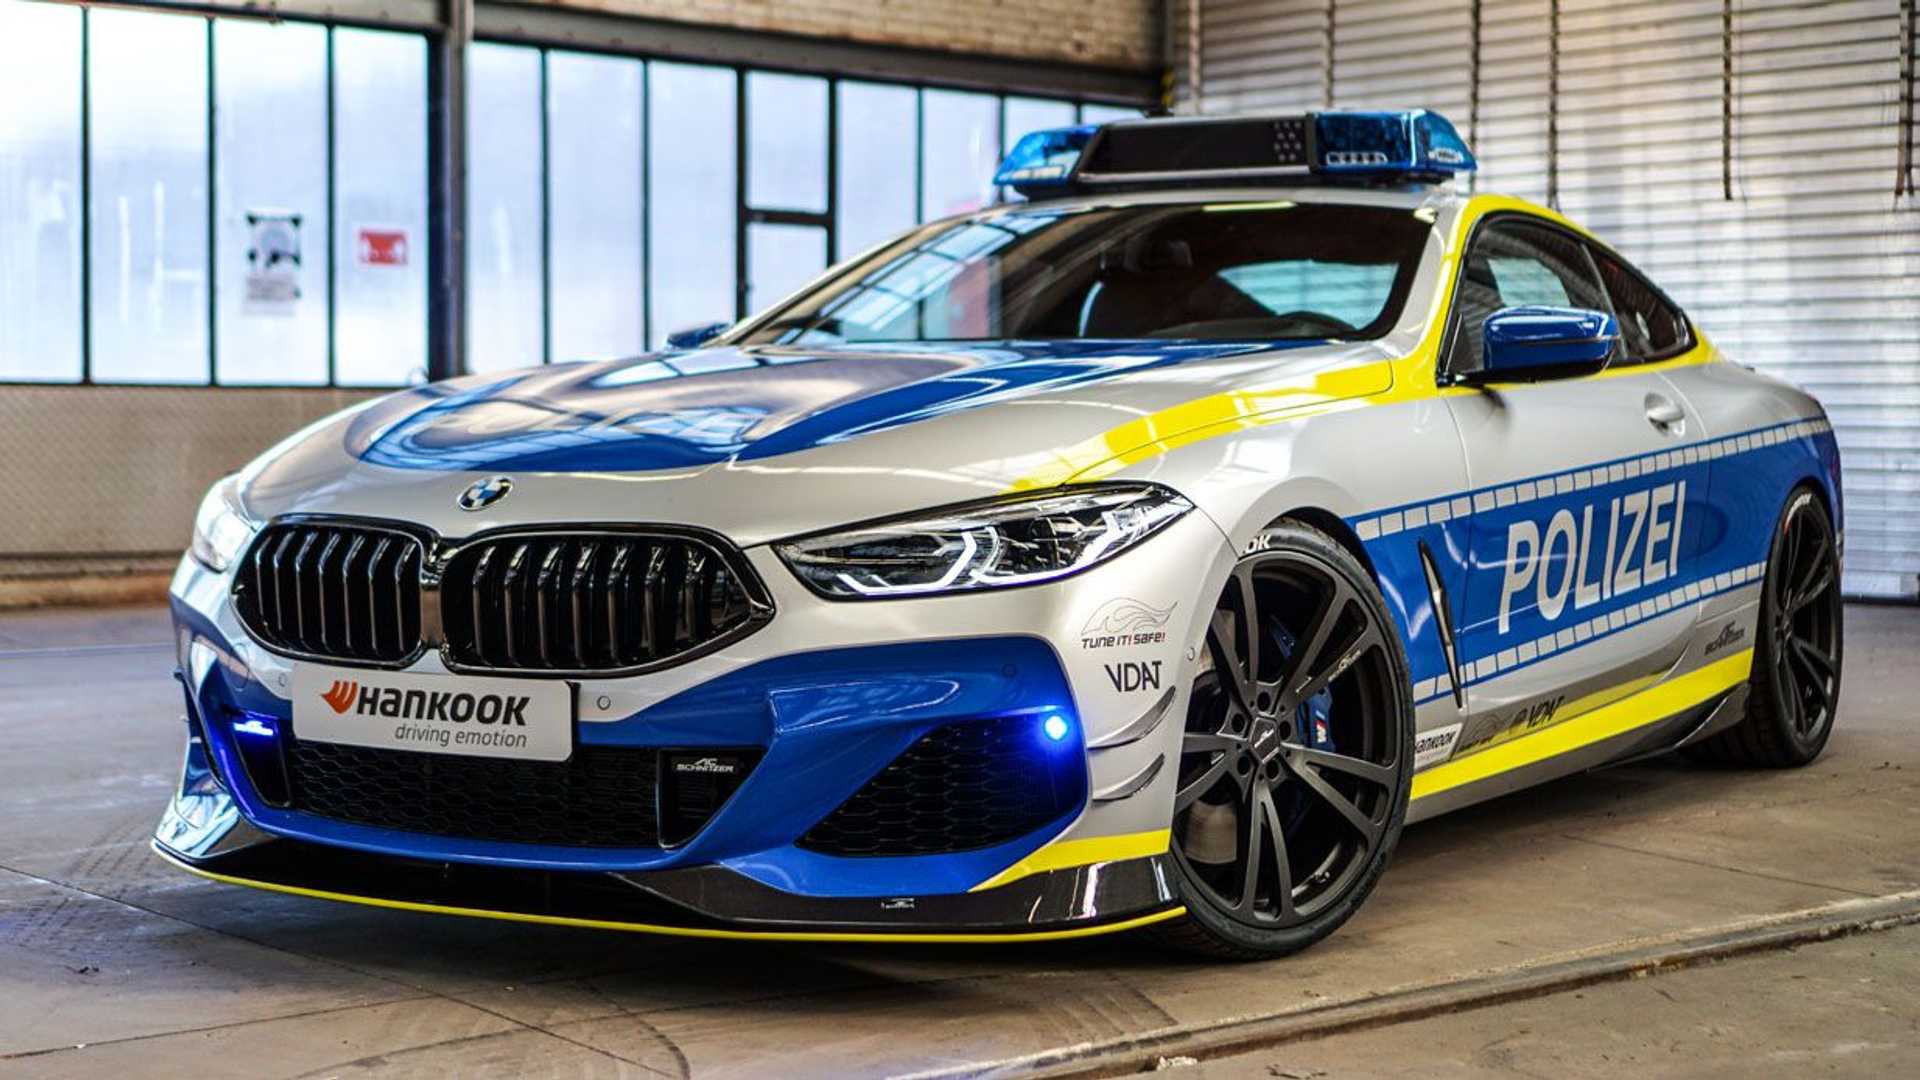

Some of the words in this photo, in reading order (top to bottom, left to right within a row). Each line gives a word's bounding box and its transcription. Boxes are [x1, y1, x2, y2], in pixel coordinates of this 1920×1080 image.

[1499, 480, 1686, 635] POLIZEI
[1104, 660, 1162, 693] VDAT
[395, 722, 451, 748] driving
[455, 729, 528, 748] emotion
